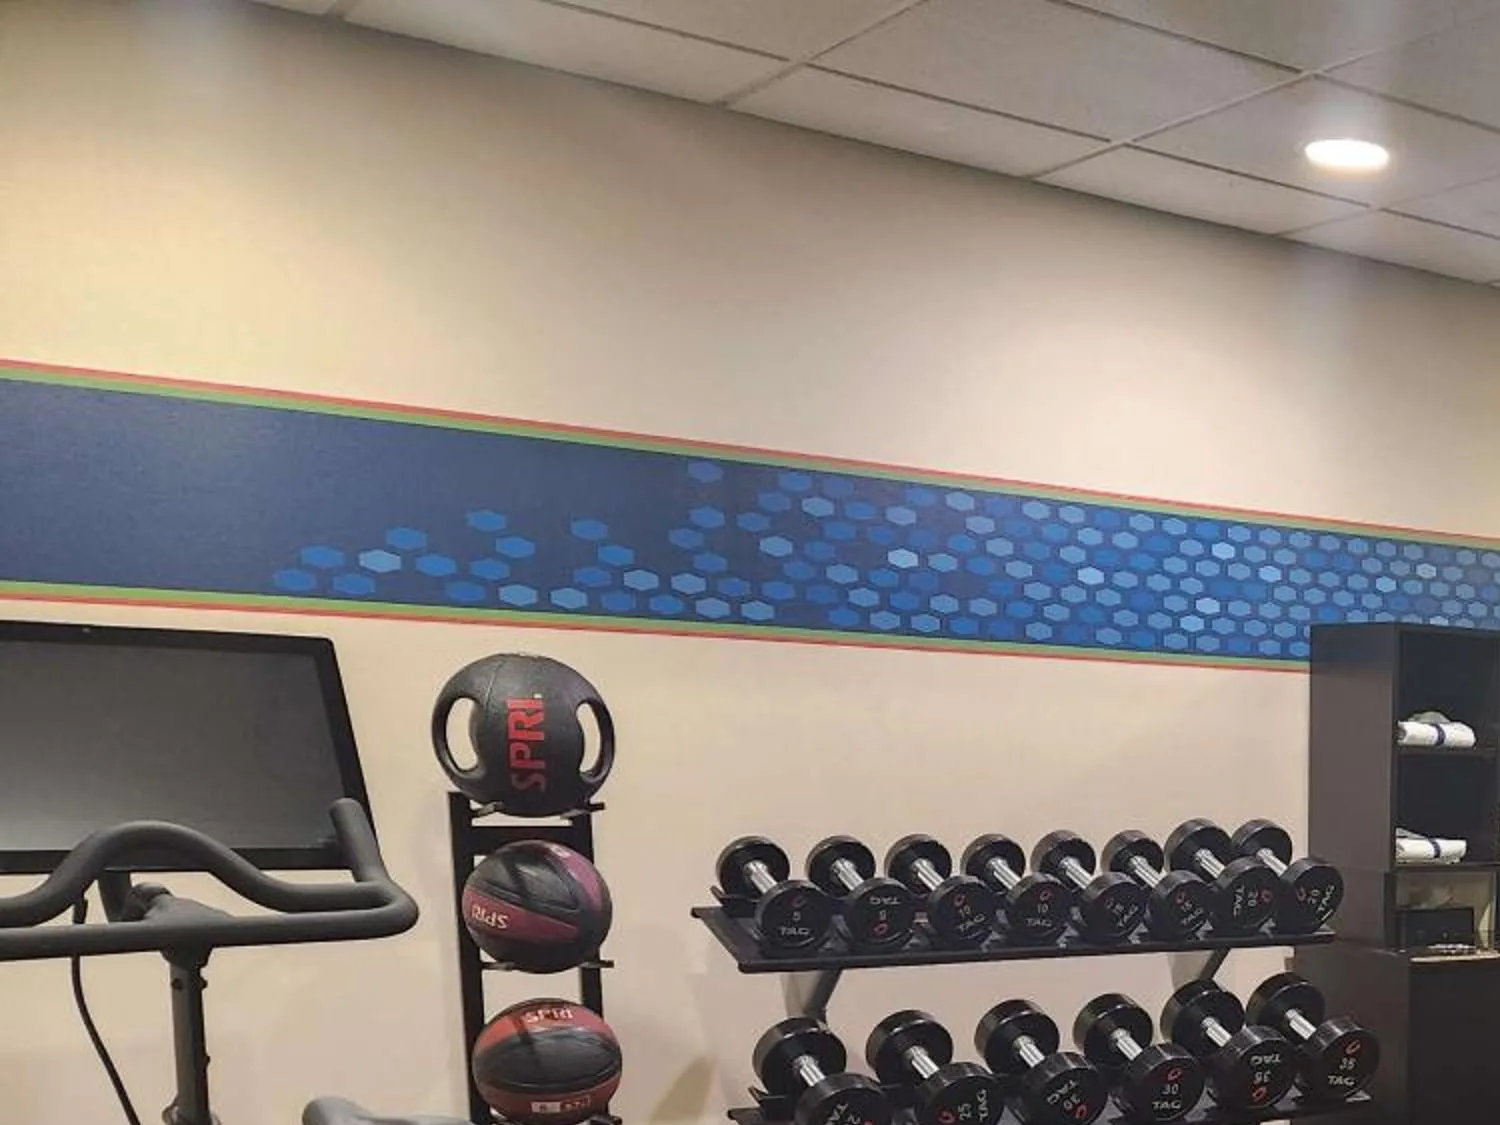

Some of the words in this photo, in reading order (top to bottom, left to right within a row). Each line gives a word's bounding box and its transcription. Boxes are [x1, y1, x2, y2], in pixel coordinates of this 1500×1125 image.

[507, 697, 546, 792] SPRI
[471, 903, 509, 930] SPRI
[1162, 1083, 1179, 1095] 30
